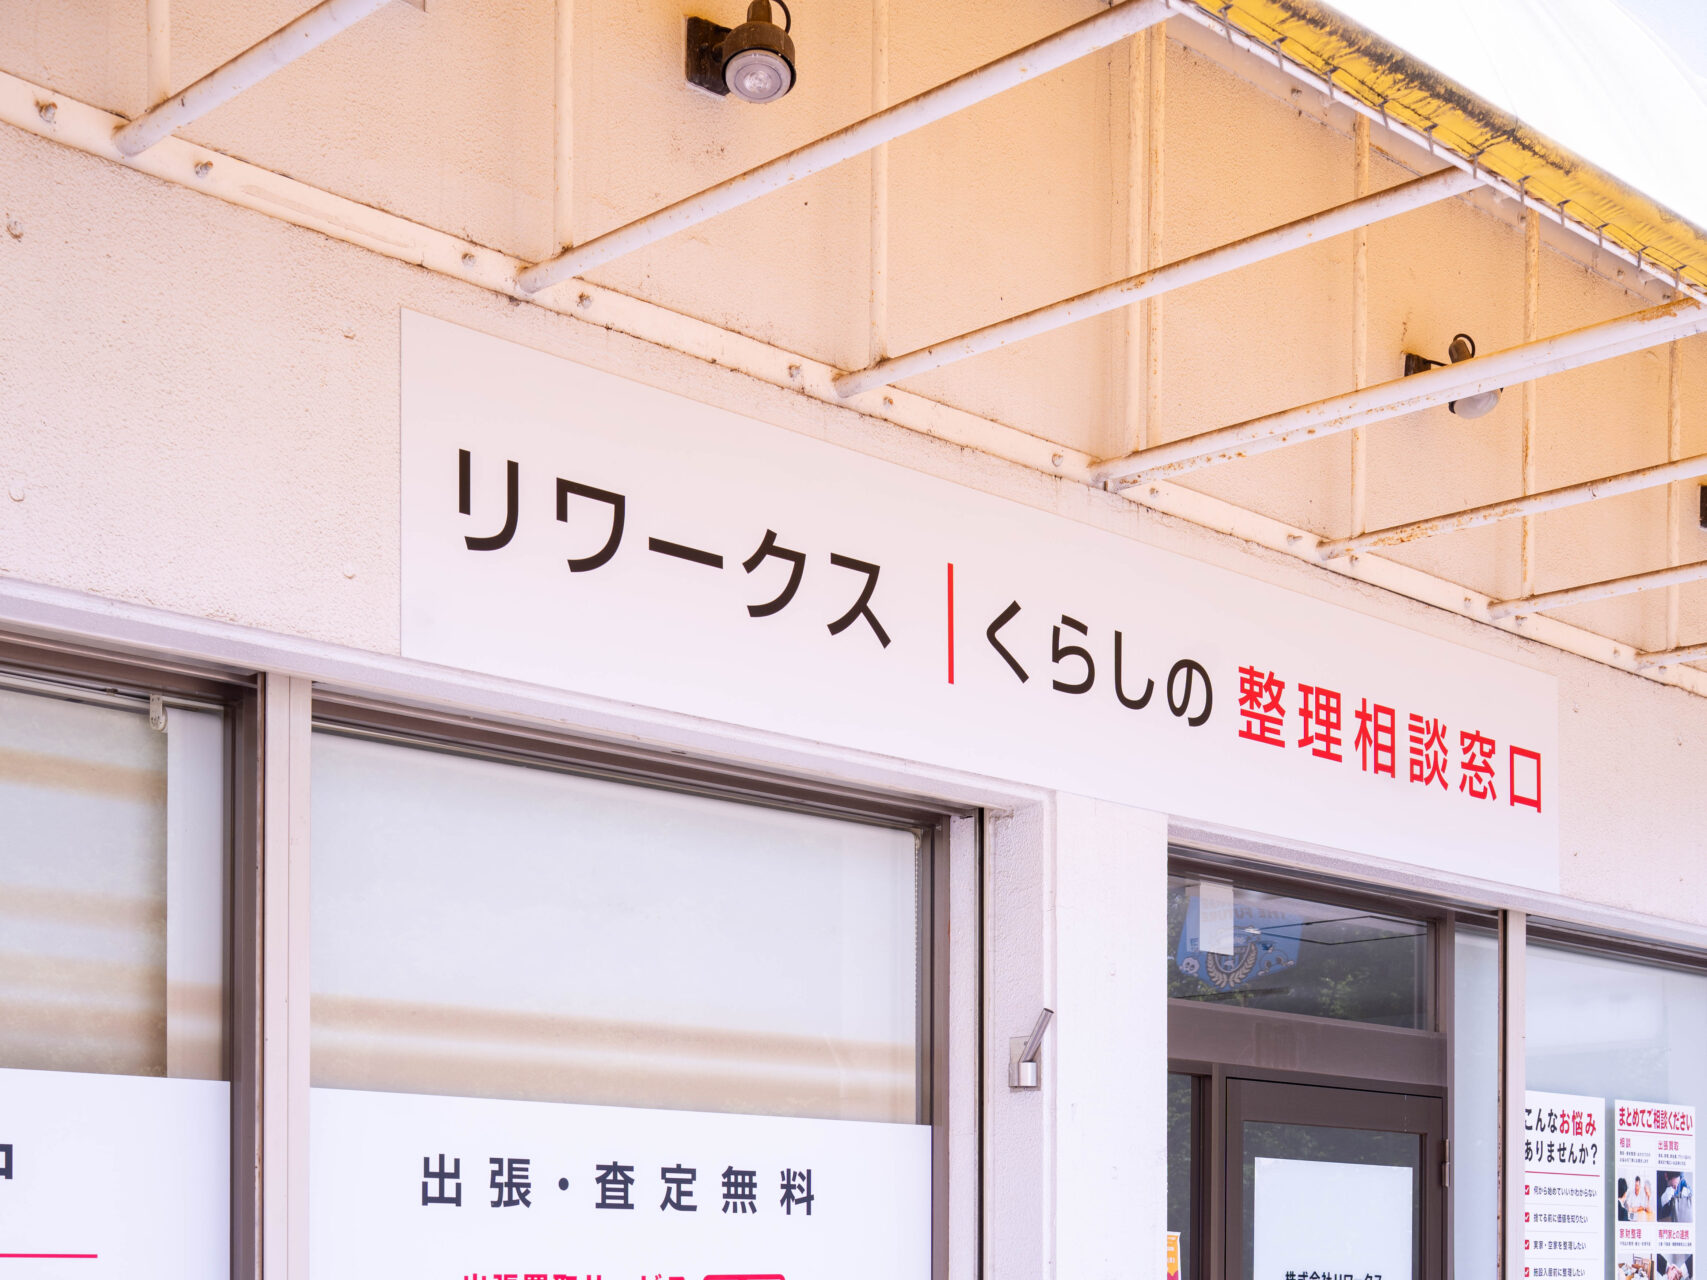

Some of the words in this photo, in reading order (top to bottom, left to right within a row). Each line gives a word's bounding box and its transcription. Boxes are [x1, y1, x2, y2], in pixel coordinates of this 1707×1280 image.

[458, 448, 892, 650] リワークス
[1619, 1106, 1693, 1131] まとめてご相談ください
[421, 1153, 815, 1216] 出張・査定無料
